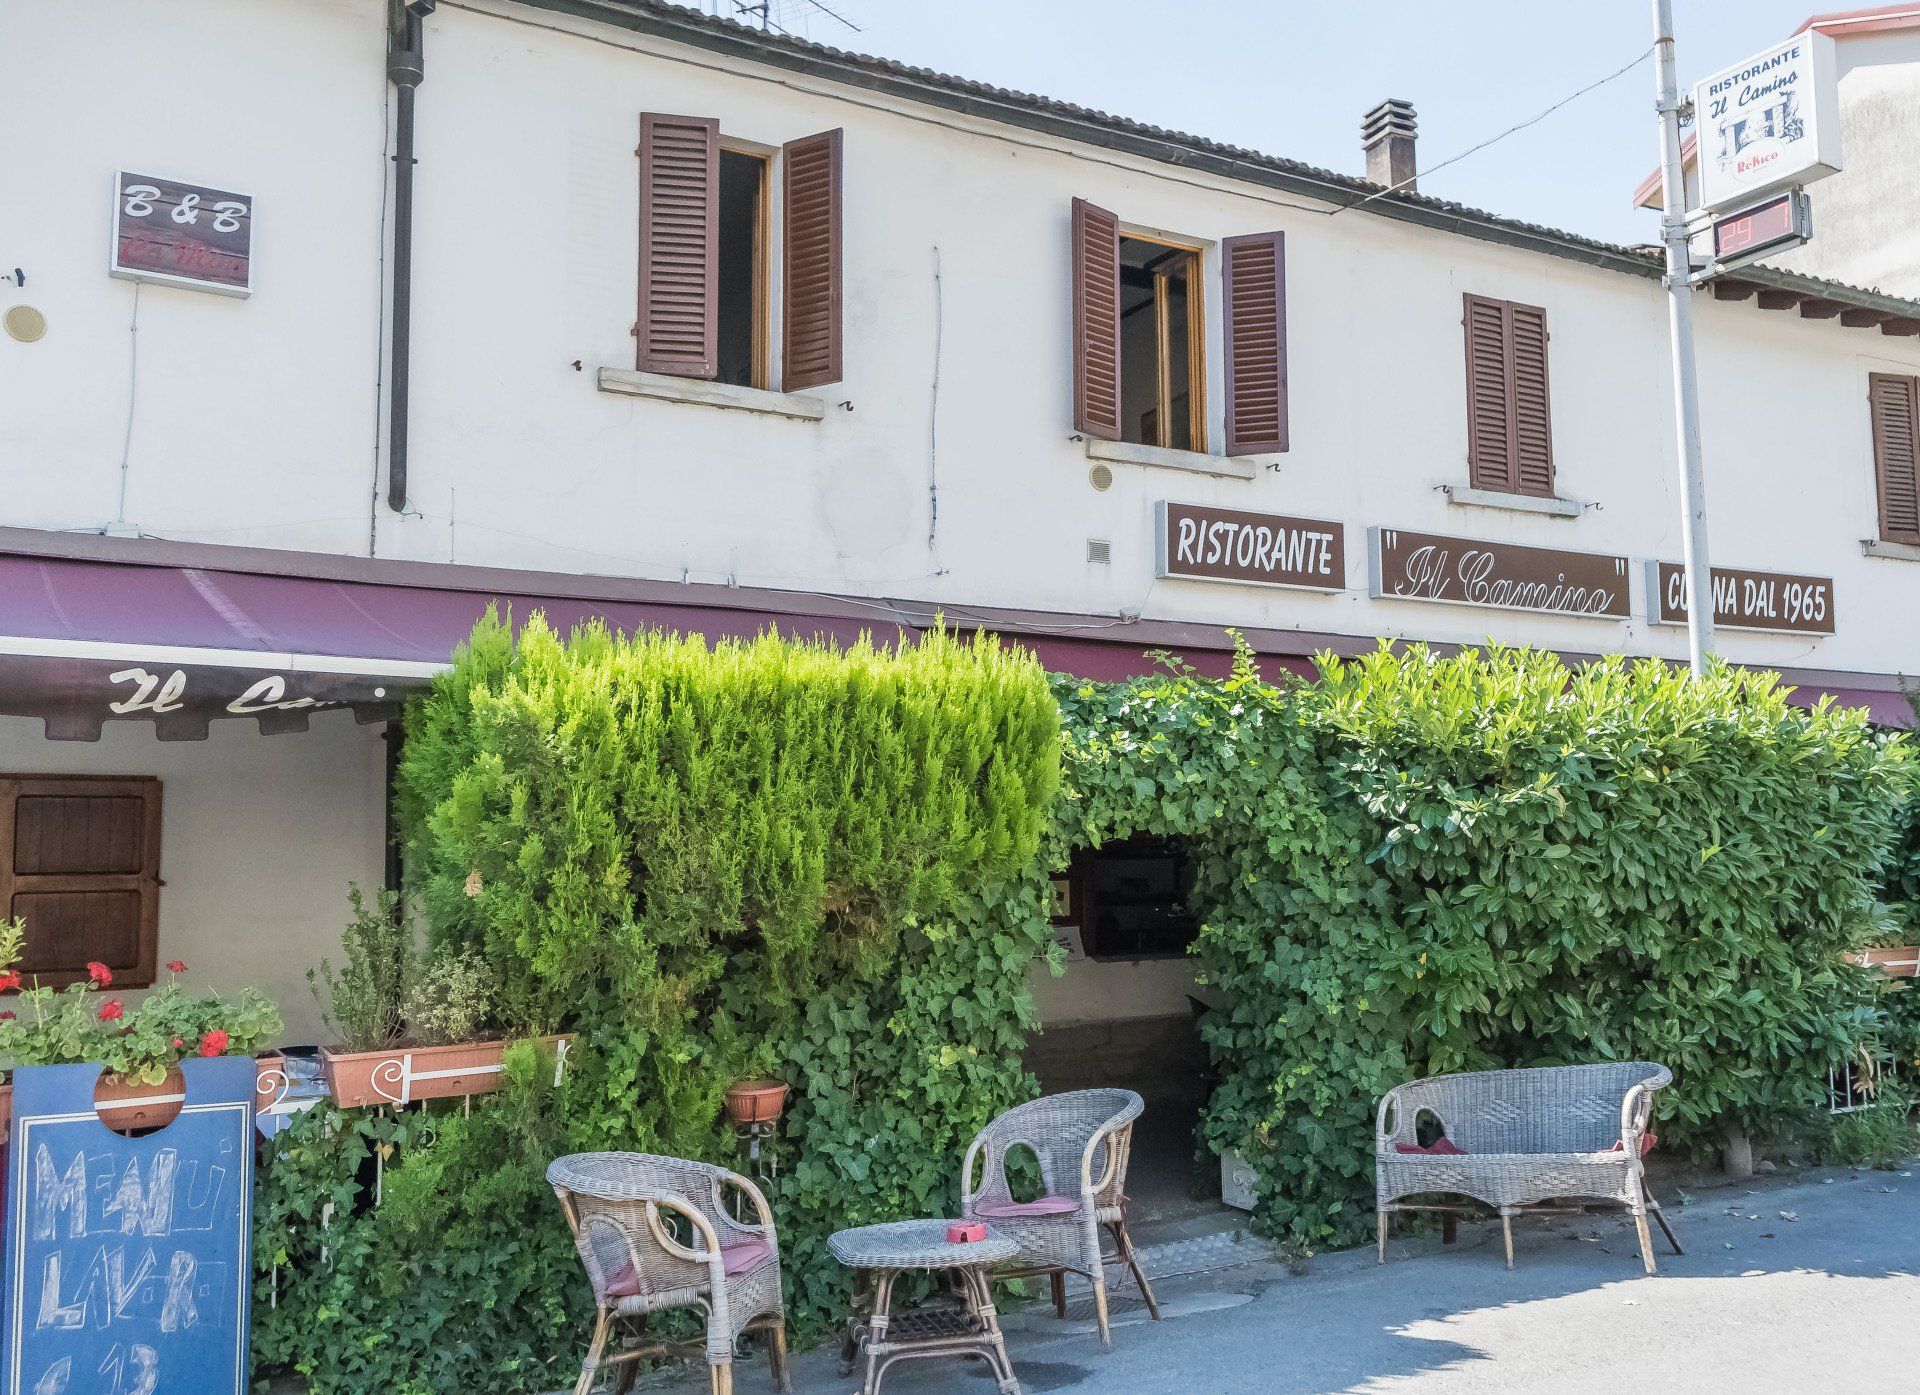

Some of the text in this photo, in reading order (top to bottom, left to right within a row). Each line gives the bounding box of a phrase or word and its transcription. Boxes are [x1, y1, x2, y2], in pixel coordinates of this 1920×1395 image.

[1710, 46, 1800, 96] RISTORANTE
[1710, 70, 1798, 119] Il Camino
[124, 184, 248, 233] B & B
[1176, 517, 1334, 575] RISTORANTE
[1668, 571, 1826, 624] CUNA DAL 1965
[109, 667, 187, 714] Il
